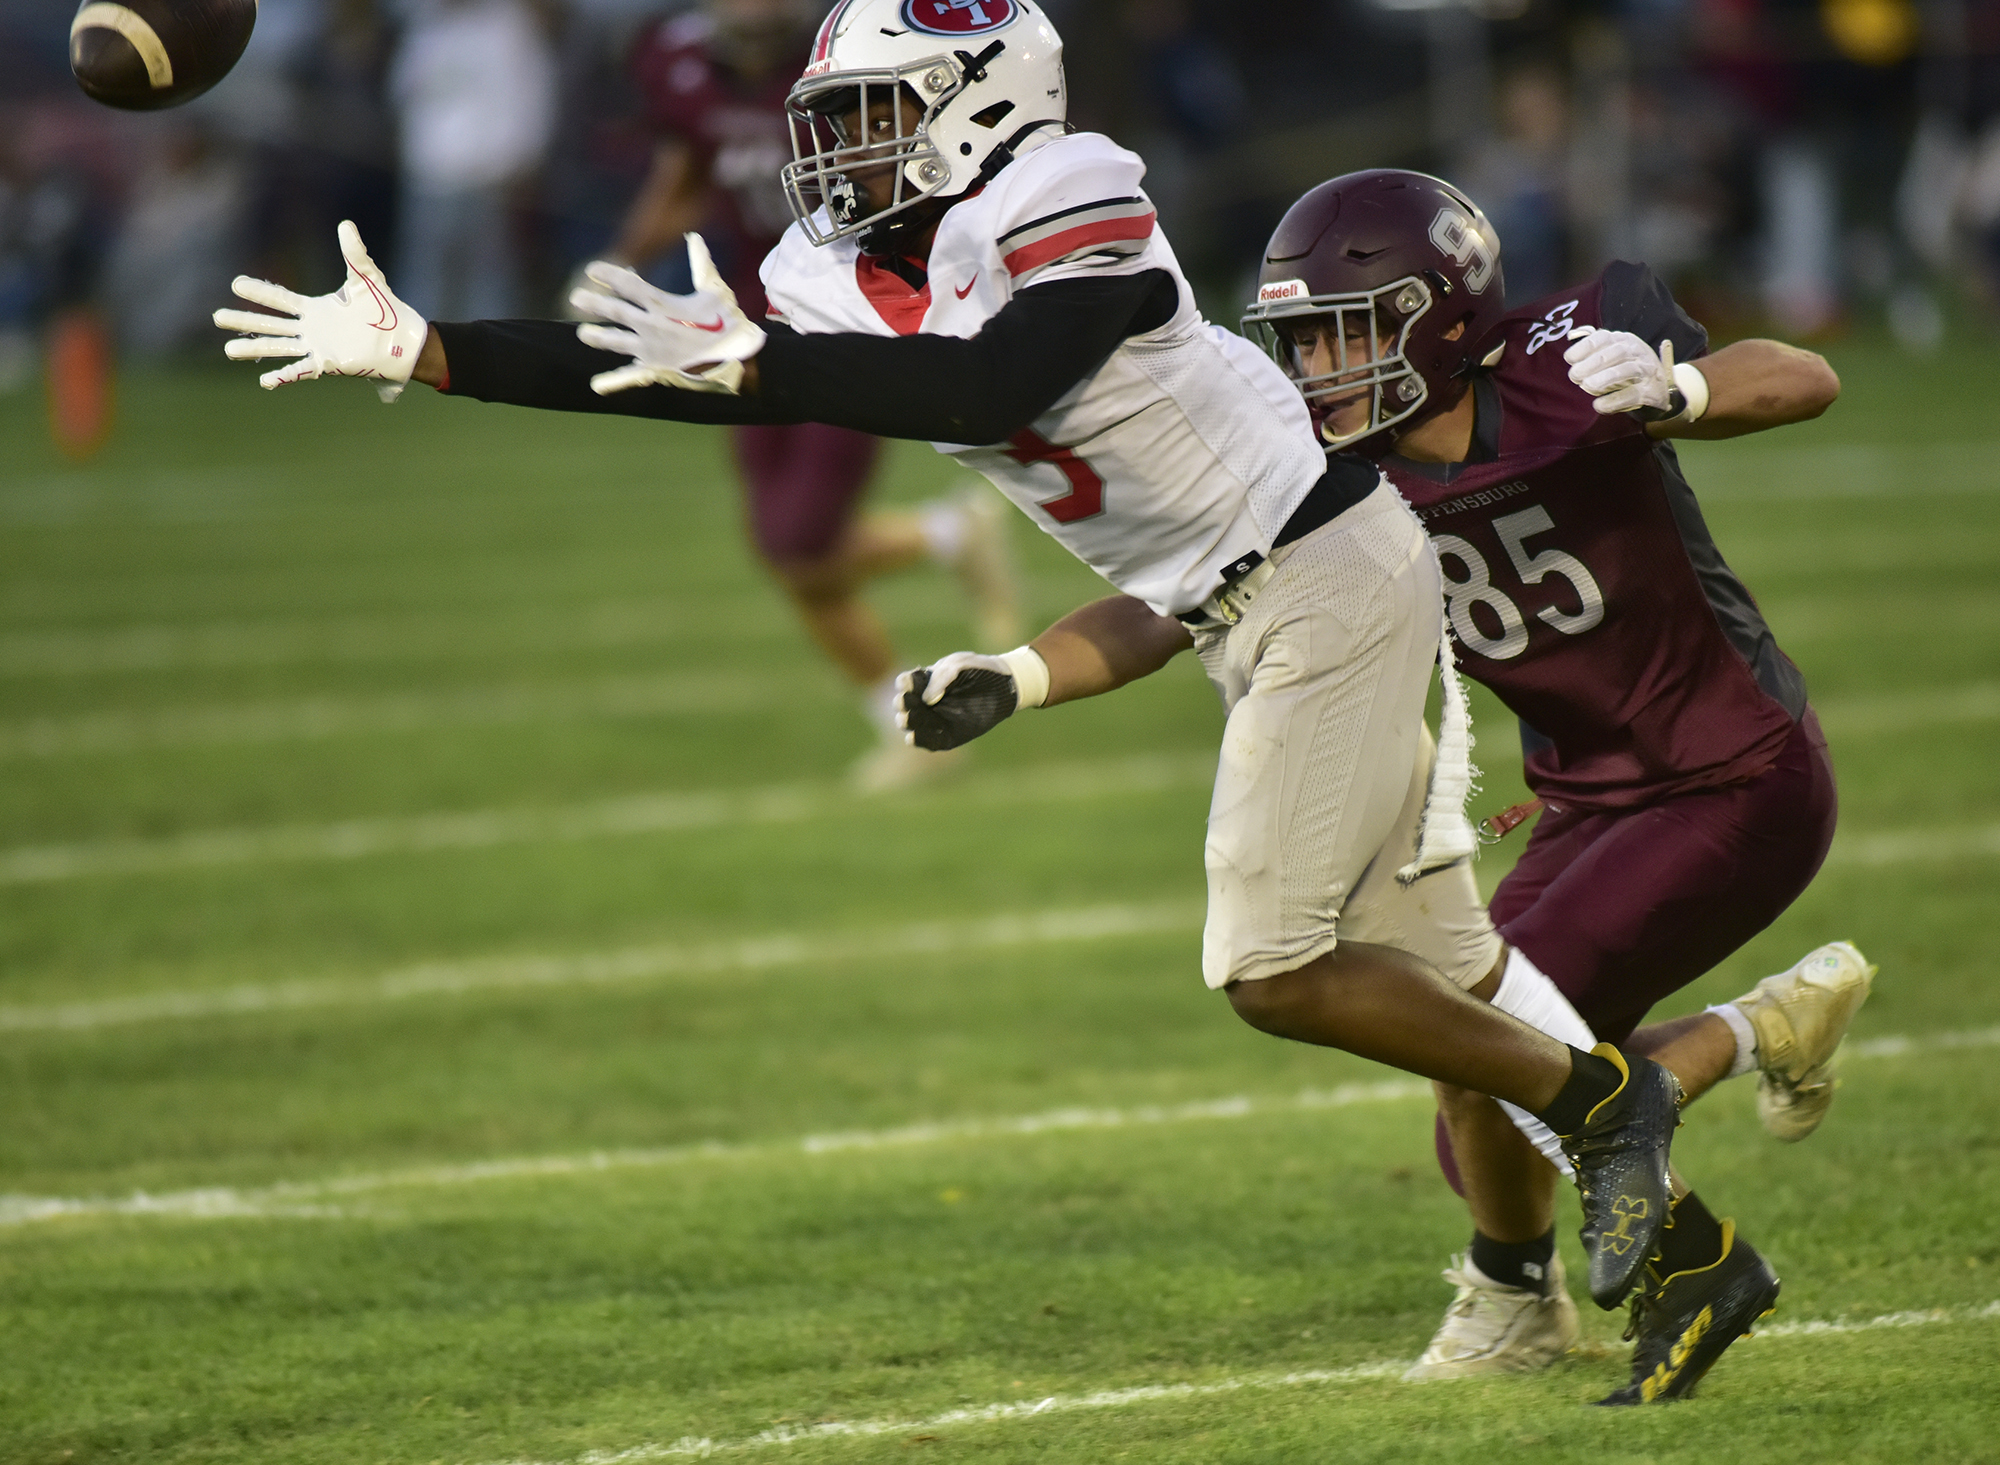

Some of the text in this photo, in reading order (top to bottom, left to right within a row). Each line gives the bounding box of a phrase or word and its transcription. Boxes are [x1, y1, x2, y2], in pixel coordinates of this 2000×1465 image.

[1428, 207, 1494, 296] S
[1261, 284, 1298, 301] Riddell
[1236, 562, 1251, 574] S
[1430, 504, 1605, 660] 85
